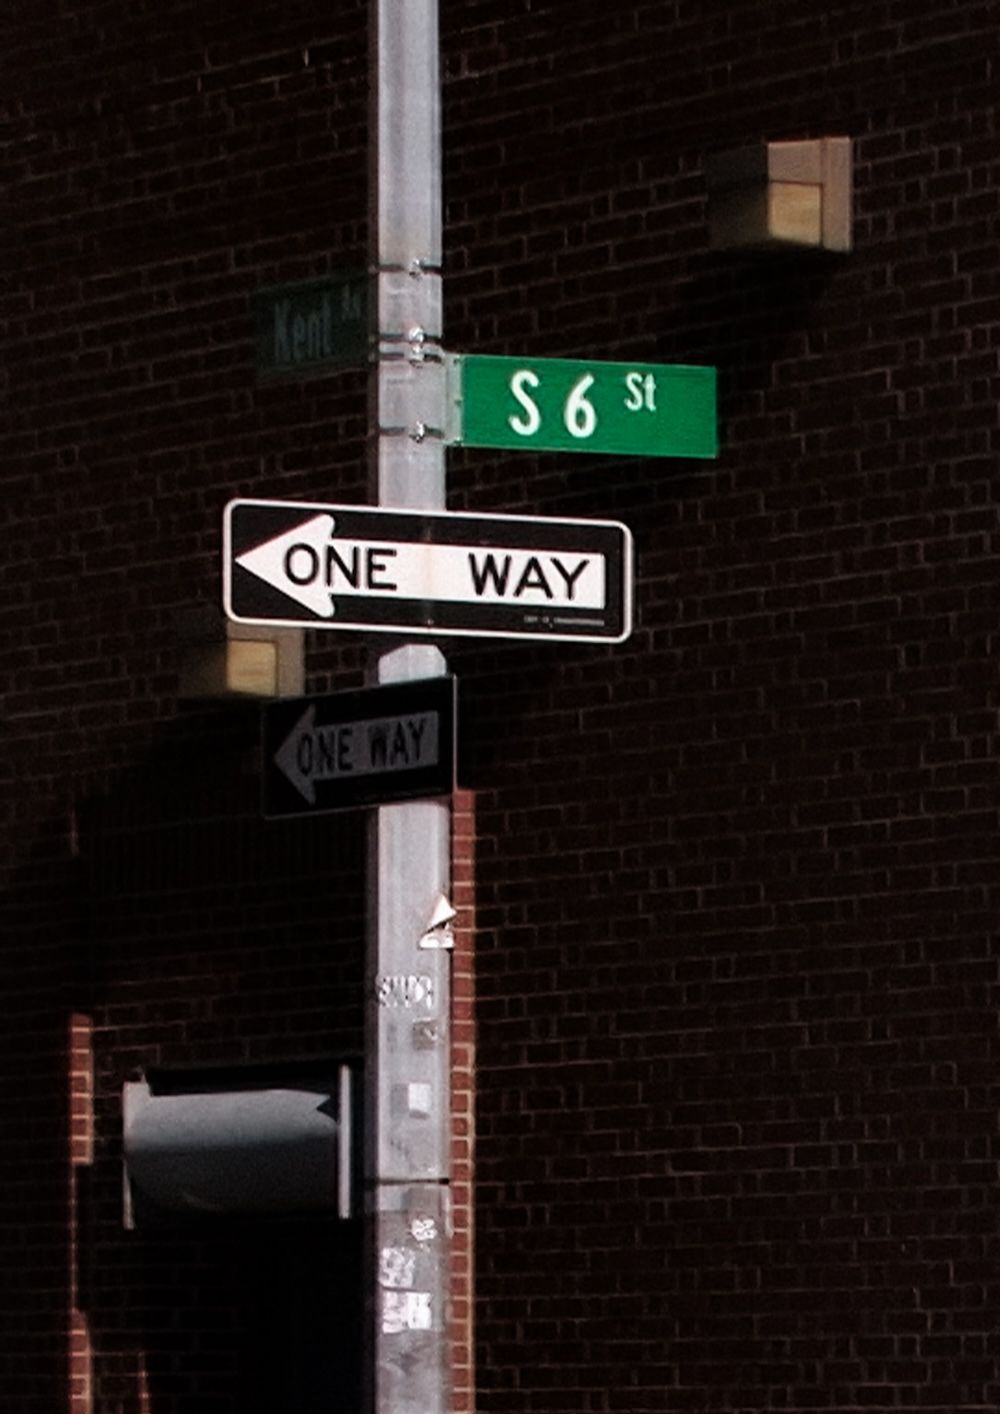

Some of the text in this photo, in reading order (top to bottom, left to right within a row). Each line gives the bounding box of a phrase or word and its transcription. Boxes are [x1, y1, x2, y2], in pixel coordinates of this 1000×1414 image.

[273, 292, 331, 363] Kent
[508, 370, 656, 438] S 6 St
[284, 543, 590, 600] ONE WAY
[296, 717, 426, 777] ONE WAY
